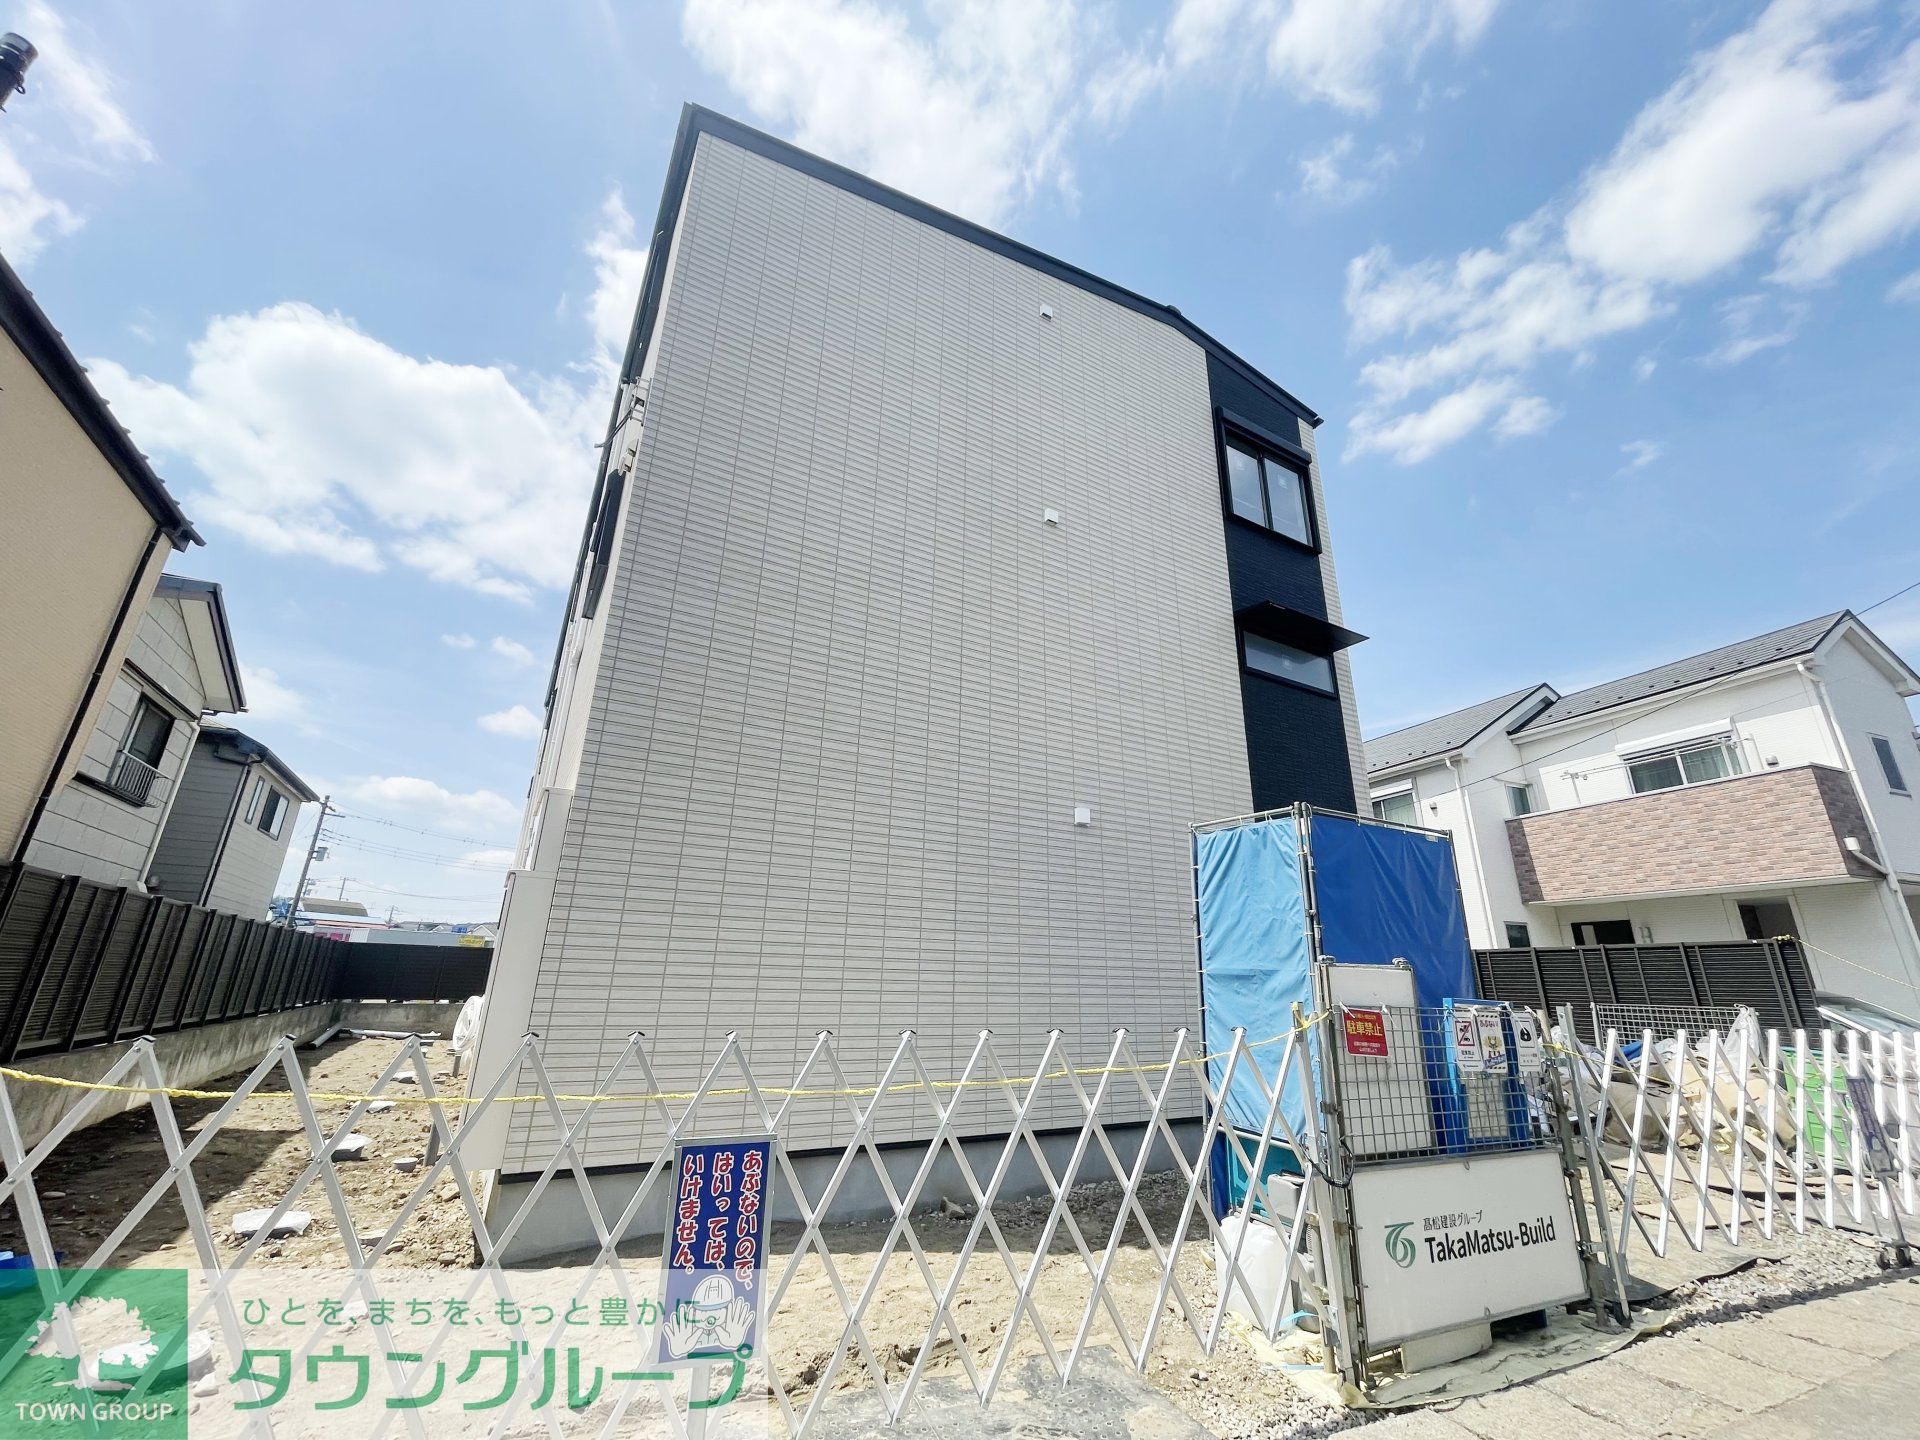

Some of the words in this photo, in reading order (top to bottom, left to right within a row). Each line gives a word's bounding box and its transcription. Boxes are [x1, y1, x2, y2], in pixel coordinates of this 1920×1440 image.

[1346, 1020, 1383, 1036] 駐車禁止
[673, 1154, 705, 1274] いけません。
[704, 1152, 734, 1271] はいっては、
[734, 1151, 763, 1290] あぶないので、
[1424, 1215, 1557, 1264] TakaMatsu-Build
